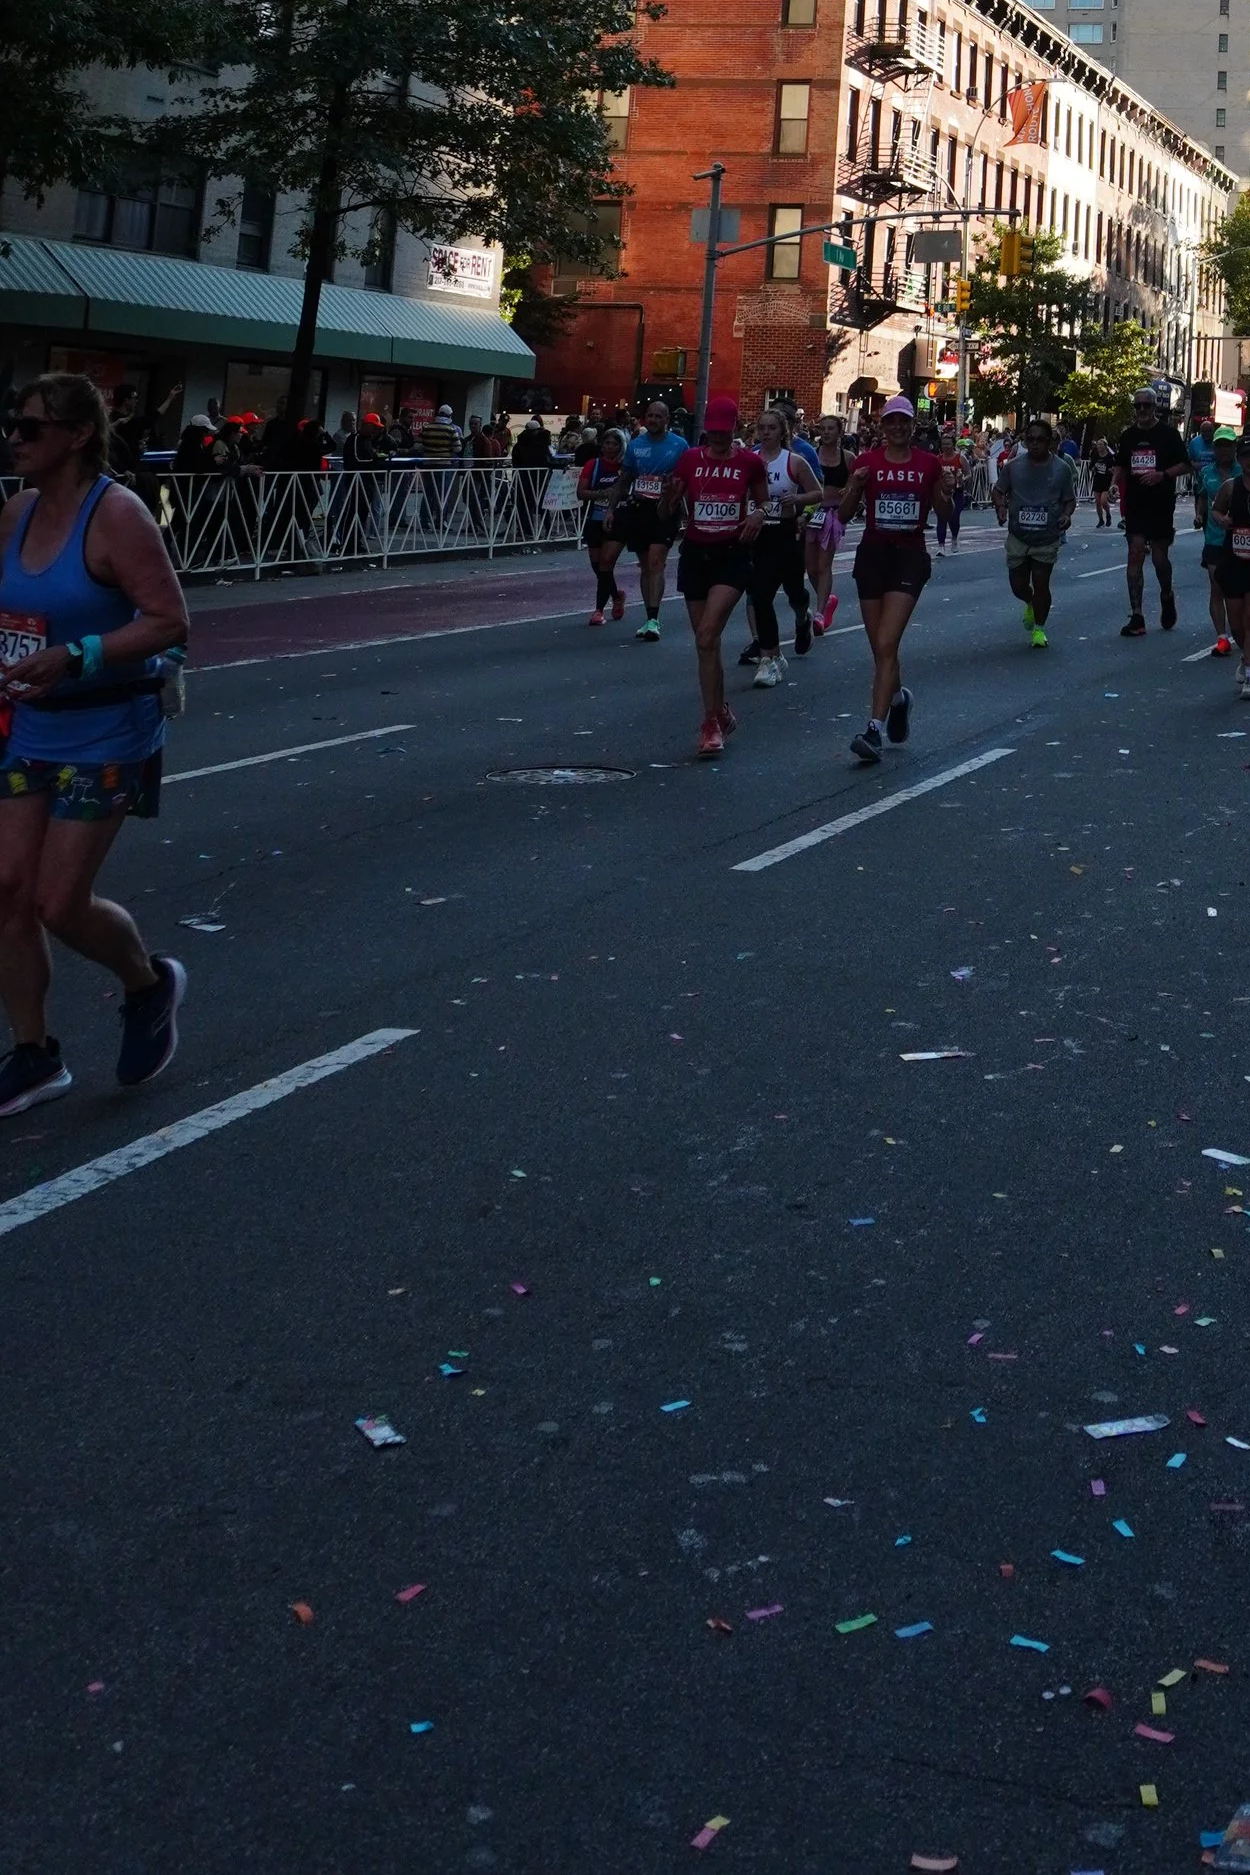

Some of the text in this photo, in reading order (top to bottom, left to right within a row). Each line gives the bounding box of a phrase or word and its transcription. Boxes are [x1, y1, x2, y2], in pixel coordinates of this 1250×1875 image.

[471, 254, 492, 277] RENT
[695, 466, 741, 481] DIANE
[876, 469, 924, 484] CASEY
[698, 503, 736, 516] 70106
[878, 501, 916, 515] 65661
